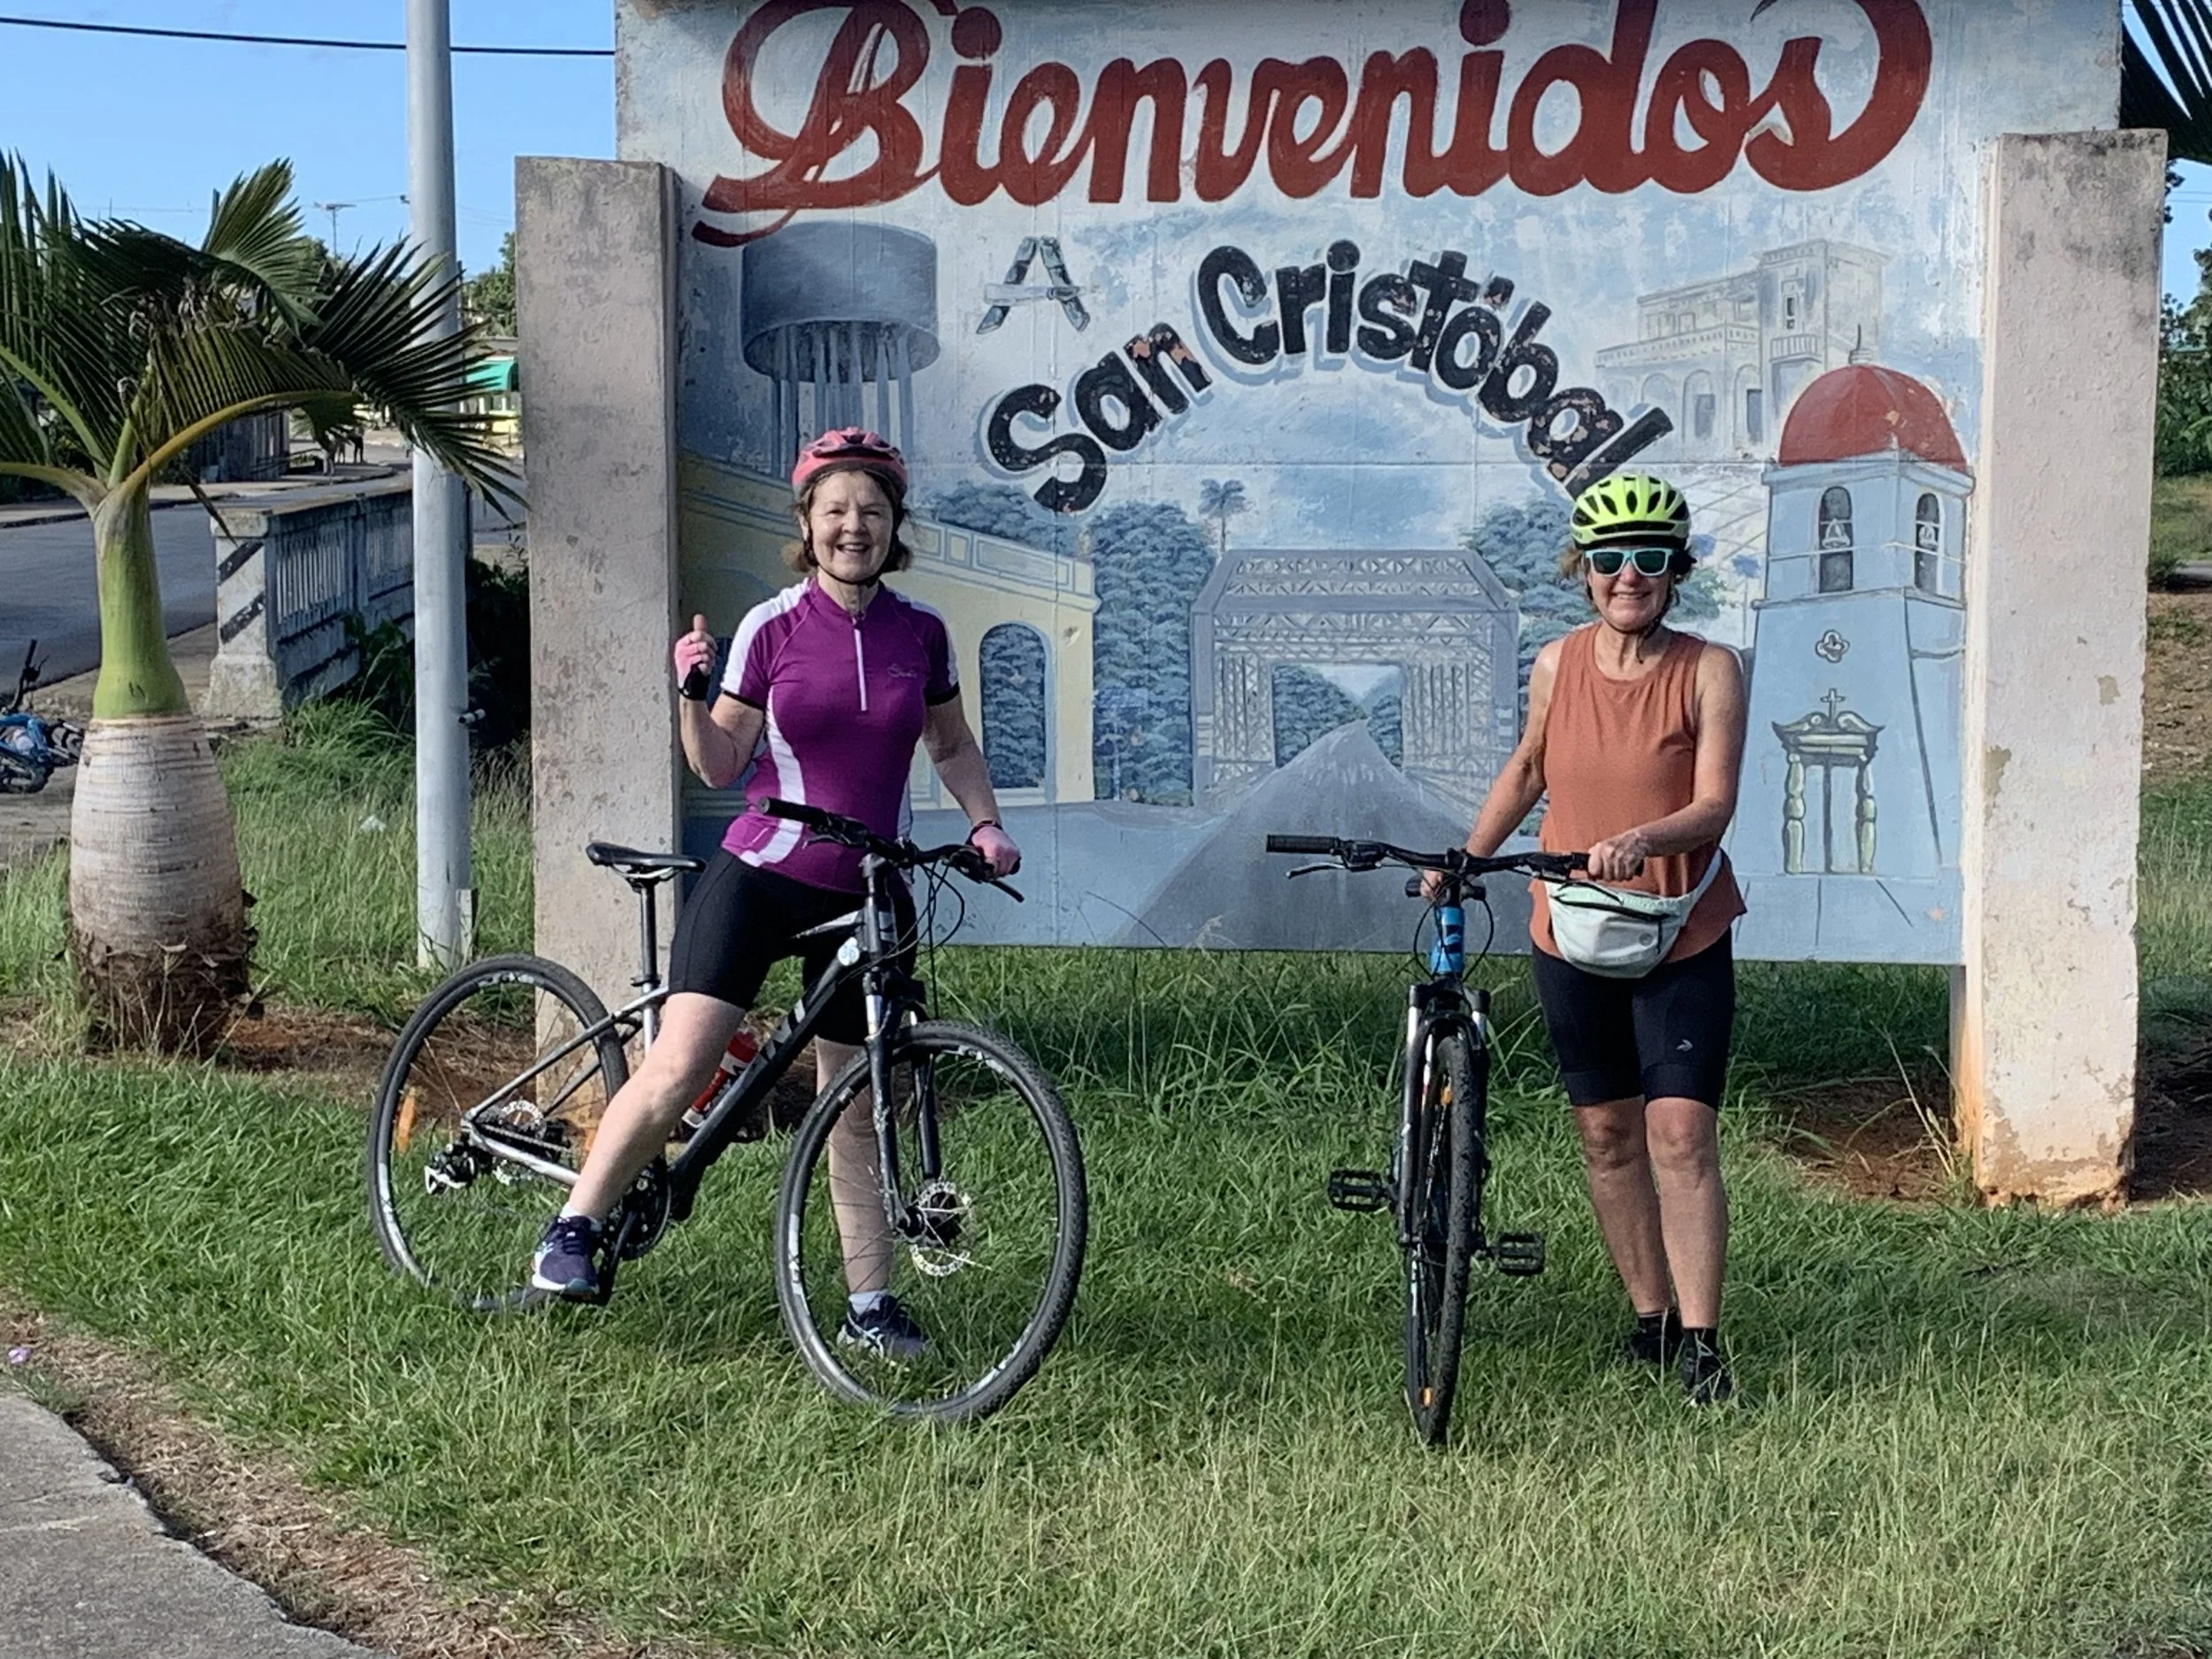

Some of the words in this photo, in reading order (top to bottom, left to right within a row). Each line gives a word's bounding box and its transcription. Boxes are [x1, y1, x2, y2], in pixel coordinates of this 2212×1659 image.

[691, 0, 1932, 248] Bienvenidos
[975, 235, 1091, 334] A
[986, 321, 1212, 513] San
[1197, 240, 1674, 501] Cristóbal
